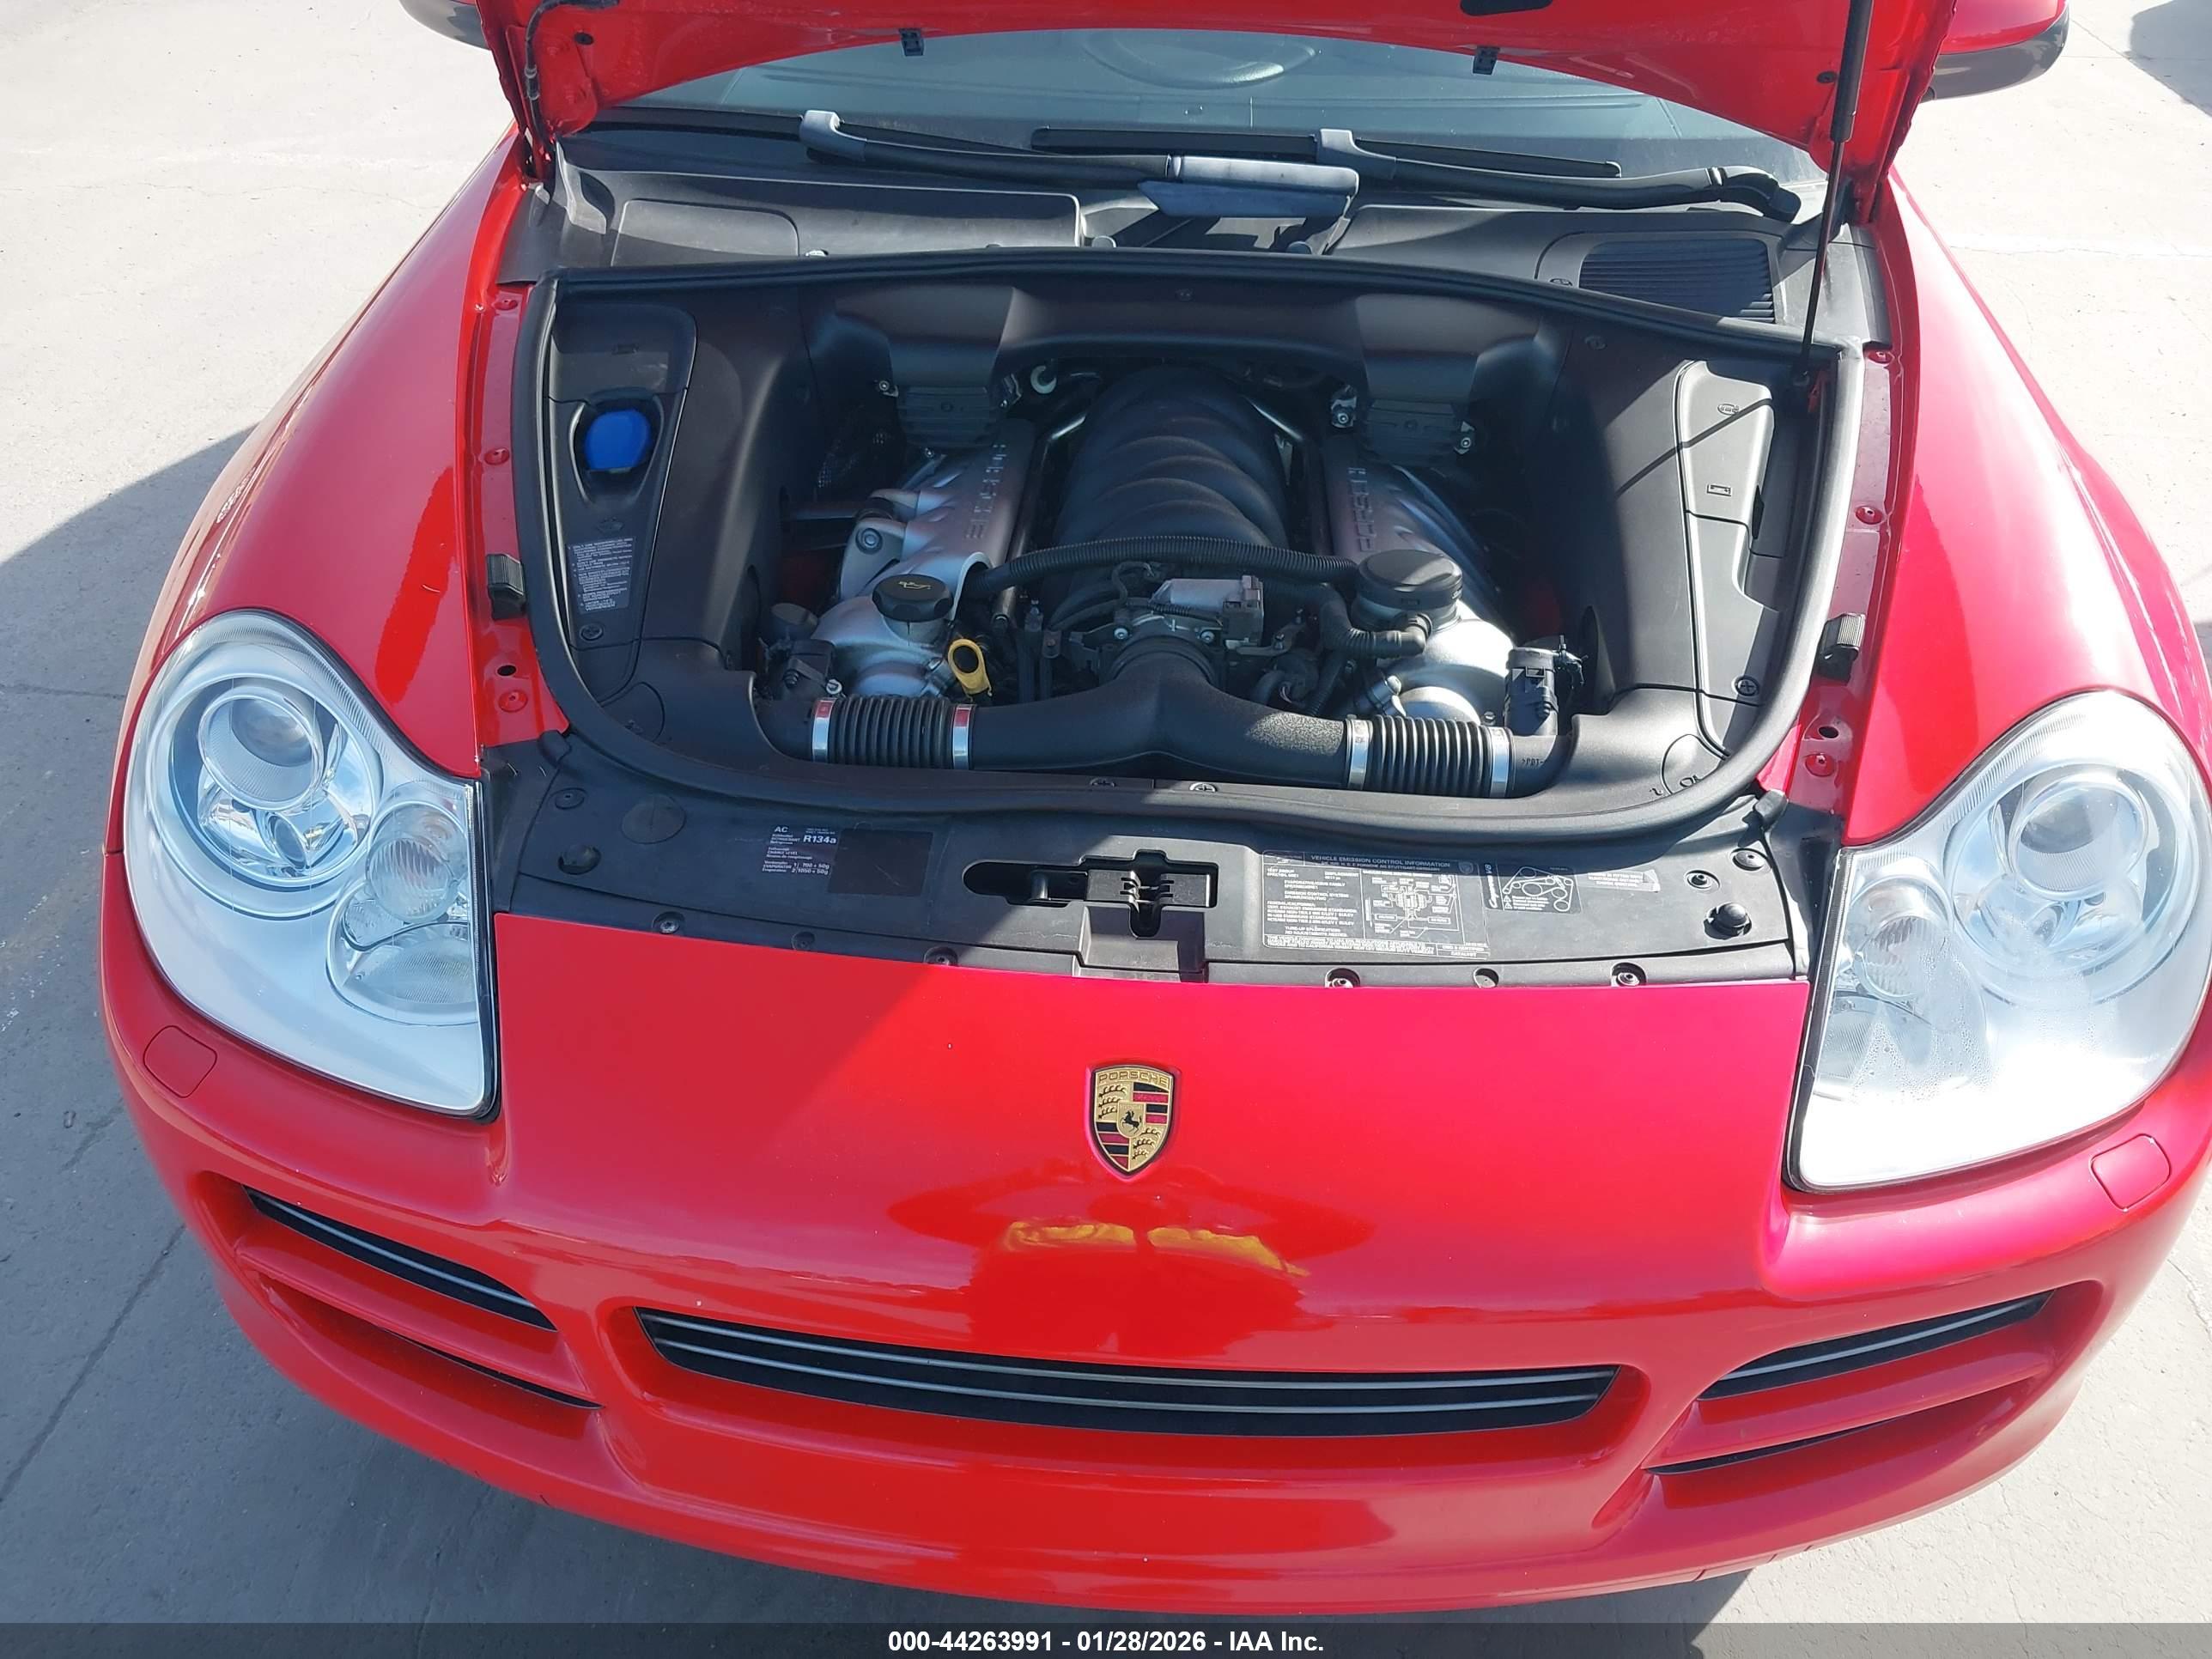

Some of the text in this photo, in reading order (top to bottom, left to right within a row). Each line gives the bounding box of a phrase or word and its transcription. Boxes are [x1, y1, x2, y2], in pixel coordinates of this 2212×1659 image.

[803, 835, 837, 844] R134a
[1339, 855, 1371, 864] EMISSION
[1098, 1071, 1170, 1087] PORSCHE
